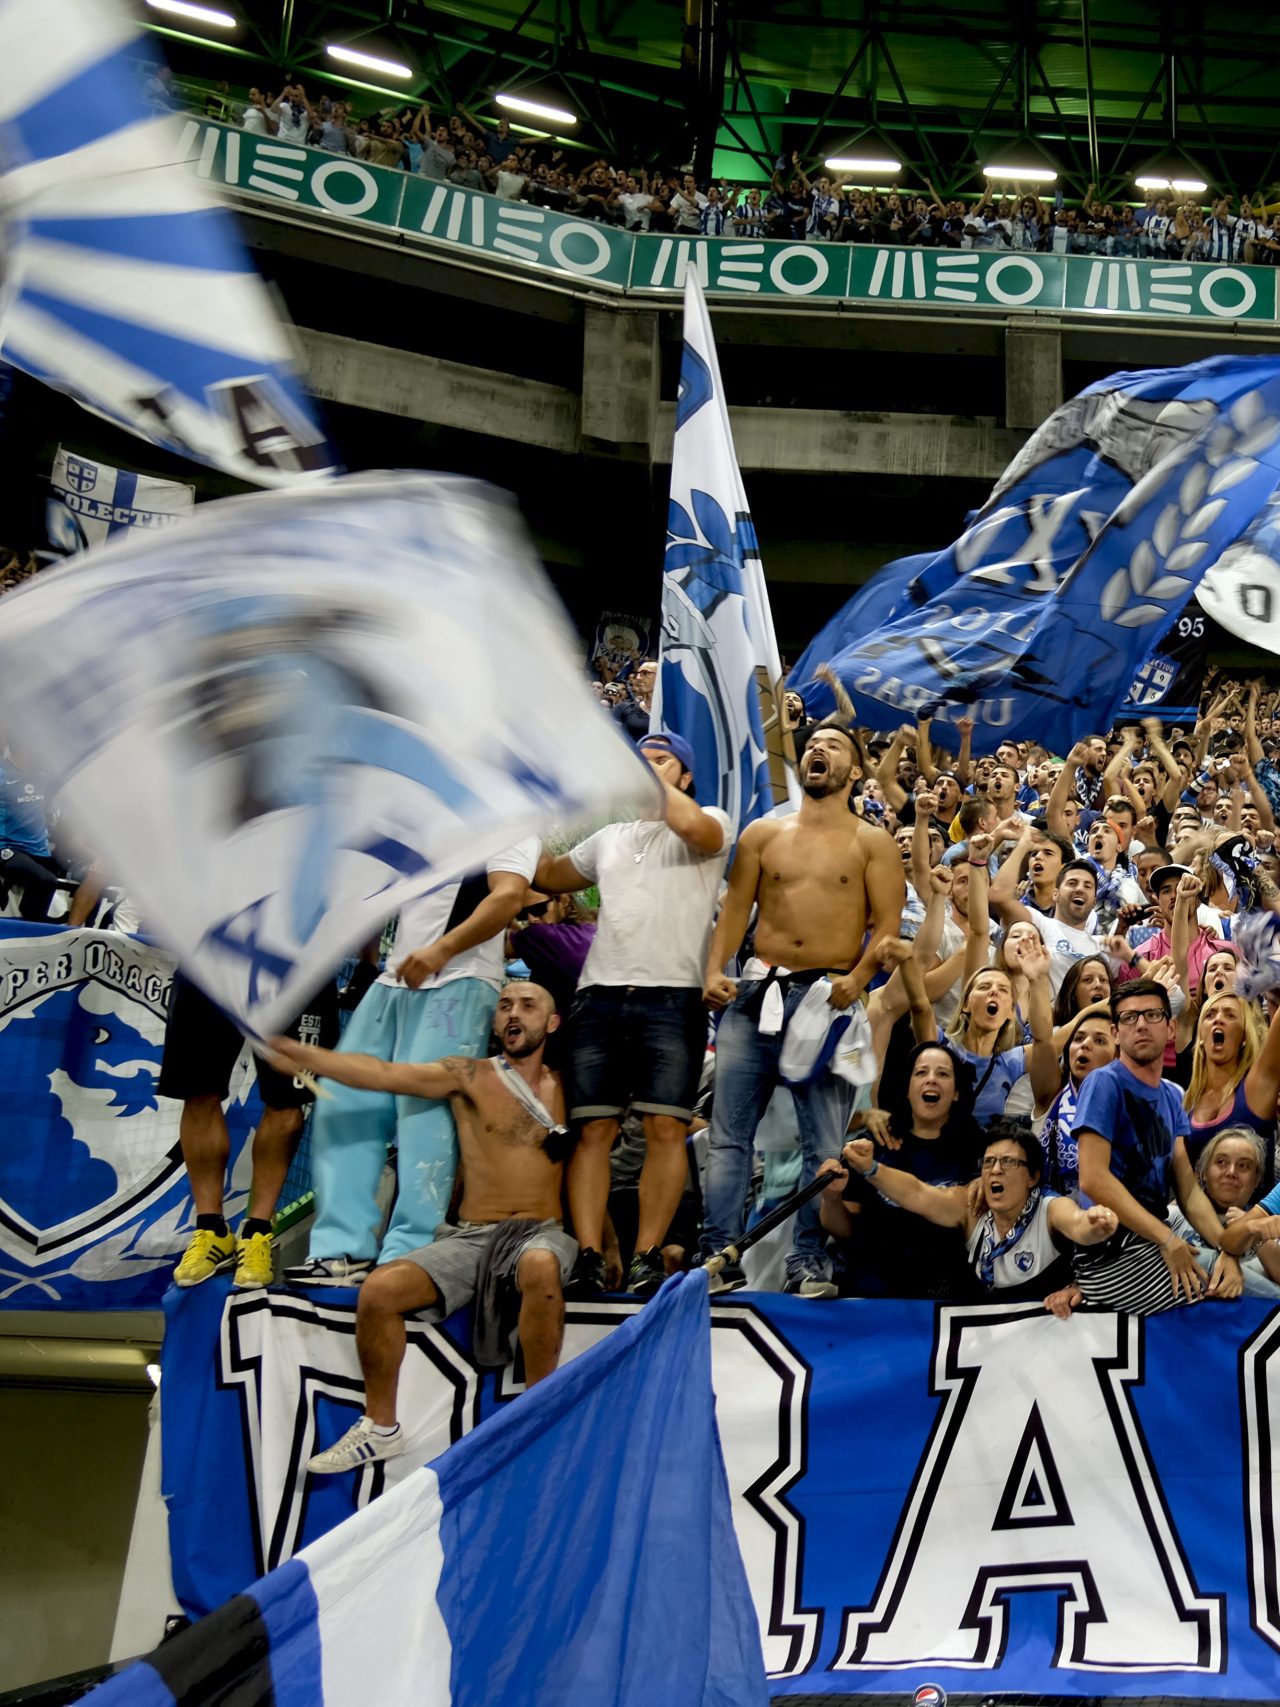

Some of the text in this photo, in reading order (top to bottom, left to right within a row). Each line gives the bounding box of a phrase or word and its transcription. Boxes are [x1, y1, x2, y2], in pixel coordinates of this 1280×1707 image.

[421, 186, 611, 275] MEO
[650, 238, 829, 295] MEO
[868, 250, 1044, 304] MEO
[1084, 261, 1257, 317] MEO
[1178, 616, 1205, 637] 95
[0, 953, 73, 1006] PER
